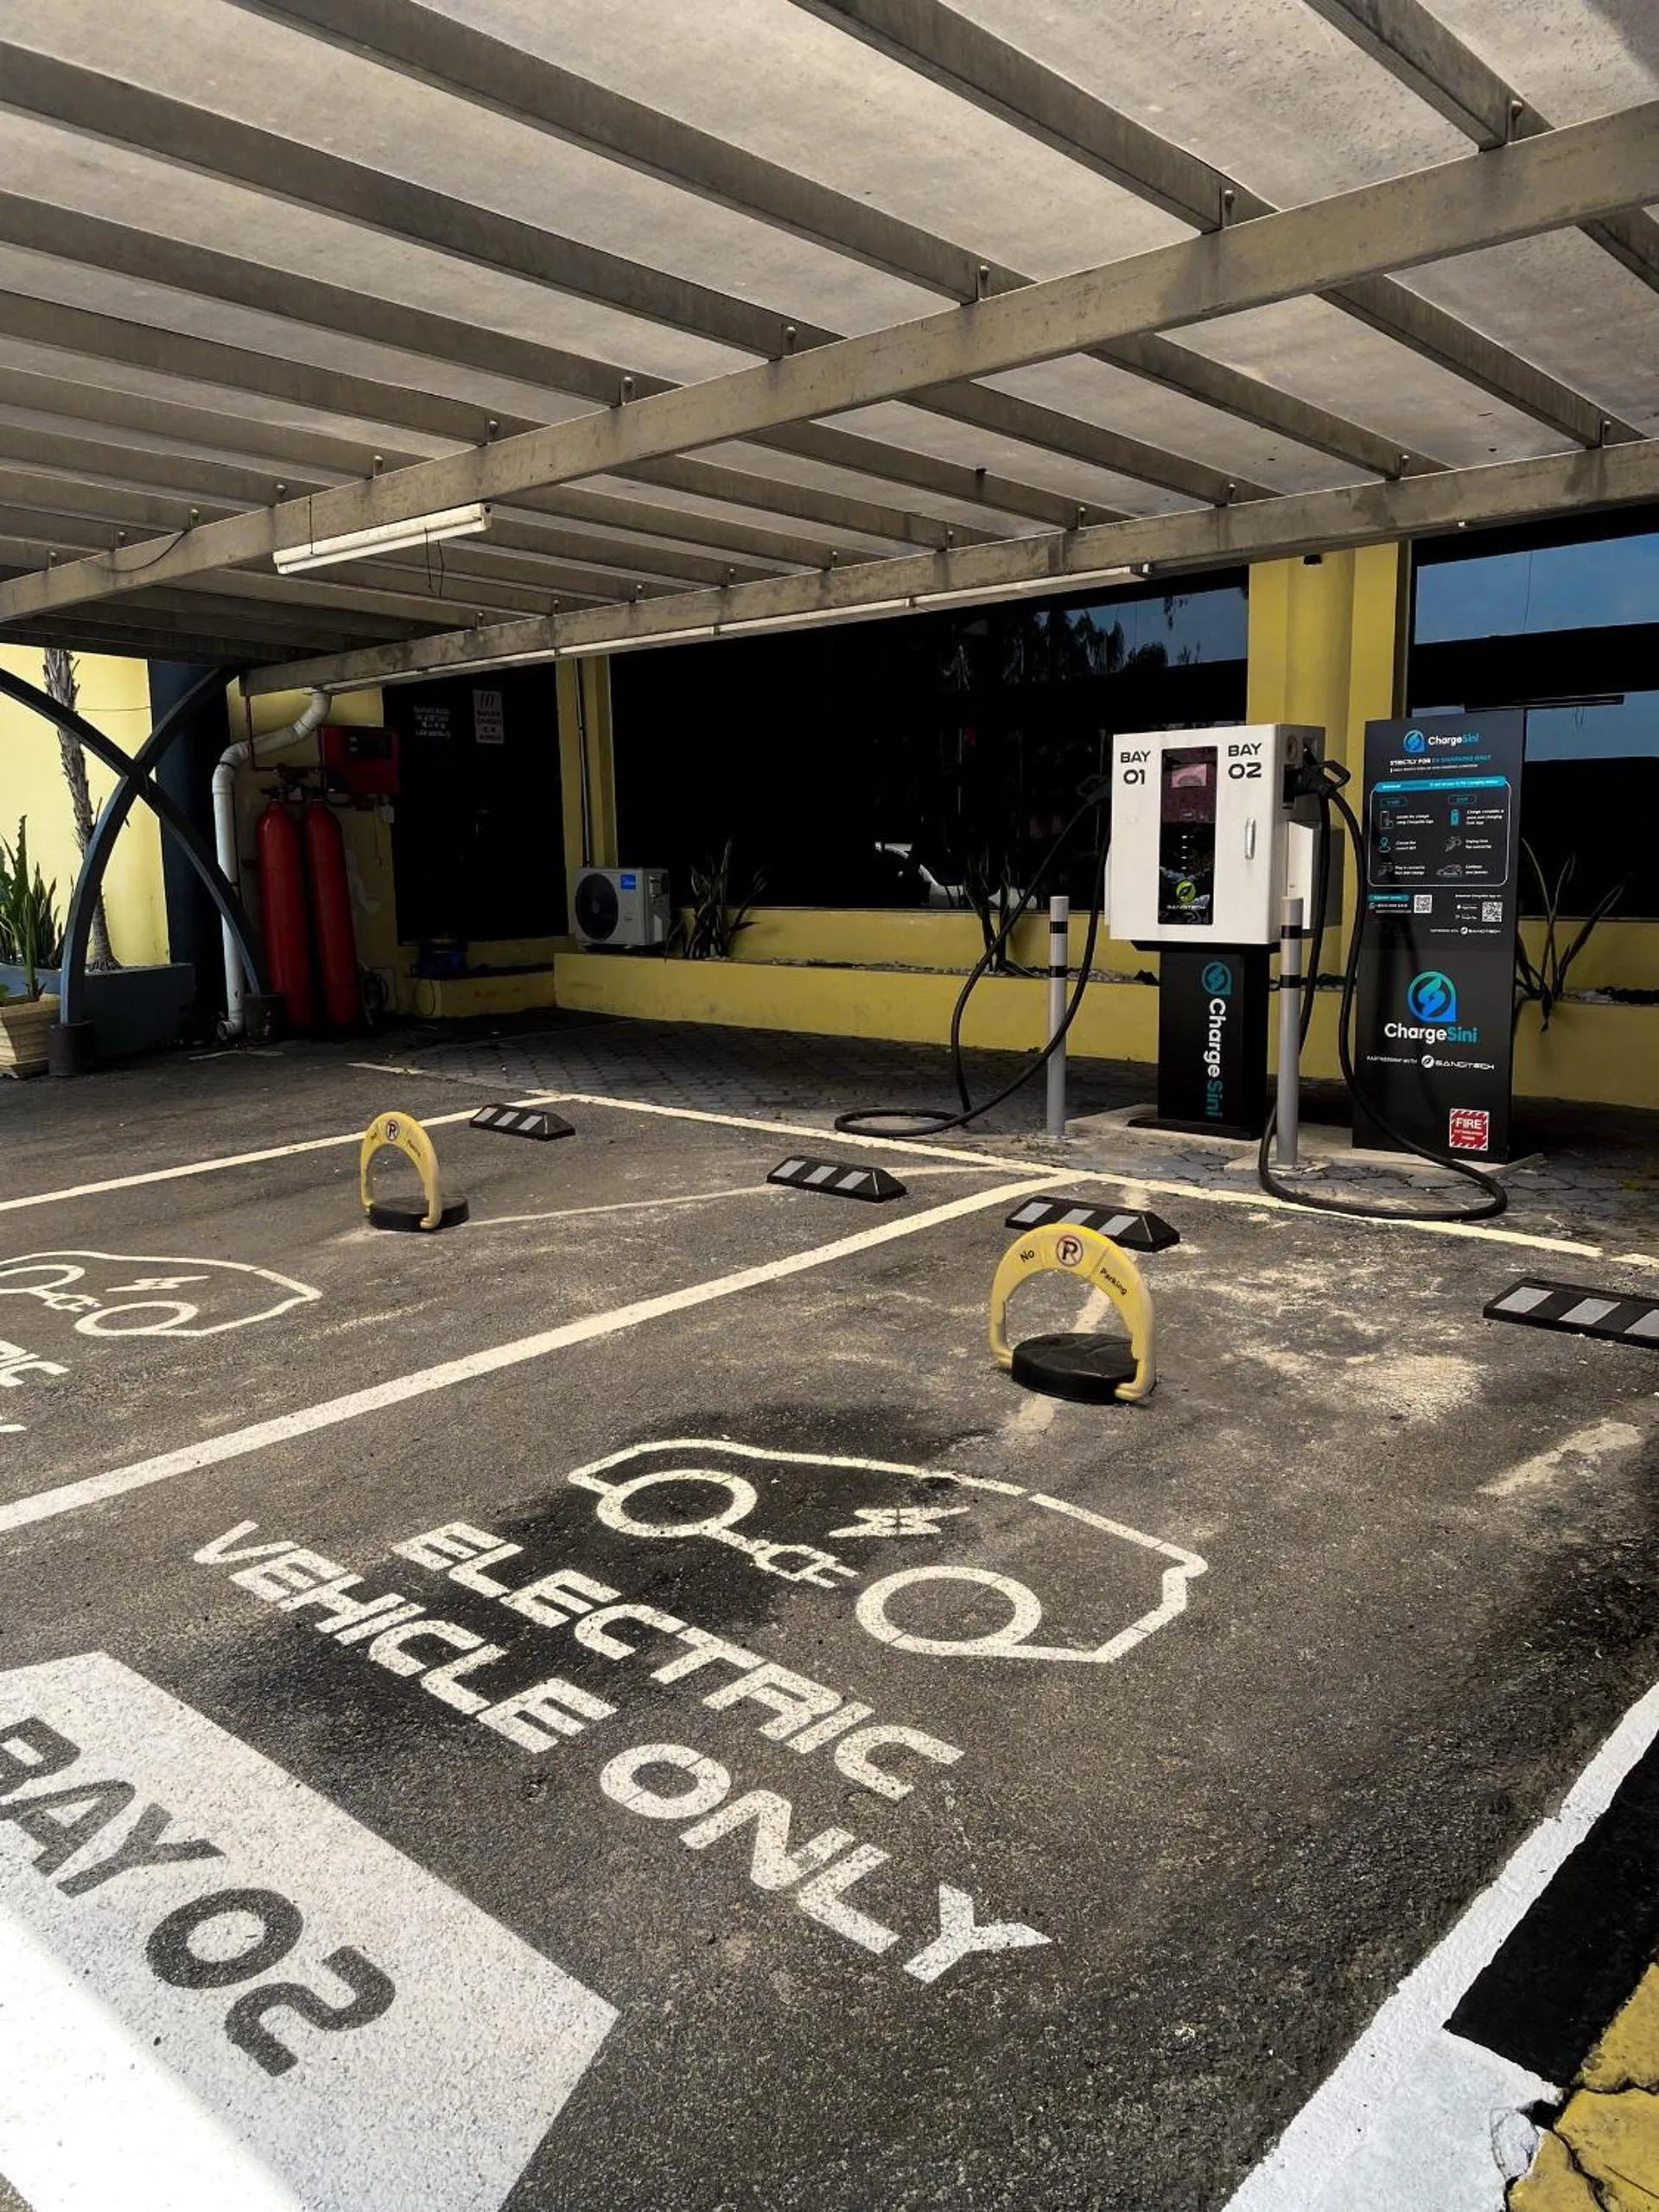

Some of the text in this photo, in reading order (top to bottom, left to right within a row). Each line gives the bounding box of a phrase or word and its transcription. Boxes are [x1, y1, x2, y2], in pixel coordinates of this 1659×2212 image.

[1120, 750, 1151, 764] BAY
[1228, 742, 1262, 758] BAY
[1122, 768, 1146, 785] 01
[1228, 762, 1262, 779] 02
[1384, 1022, 1478, 1045] ChargeSini
[1203, 998, 1227, 1118] ChargeSini
[1456, 1117, 1483, 1130] FIRE
[1100, 1267, 1128, 1296] Parking
[391, 1521, 965, 1802] ELECTRIC
[194, 1520, 1053, 1985] VEHICLE ONLY
[0, 1717, 397, 2078] BAY 02
